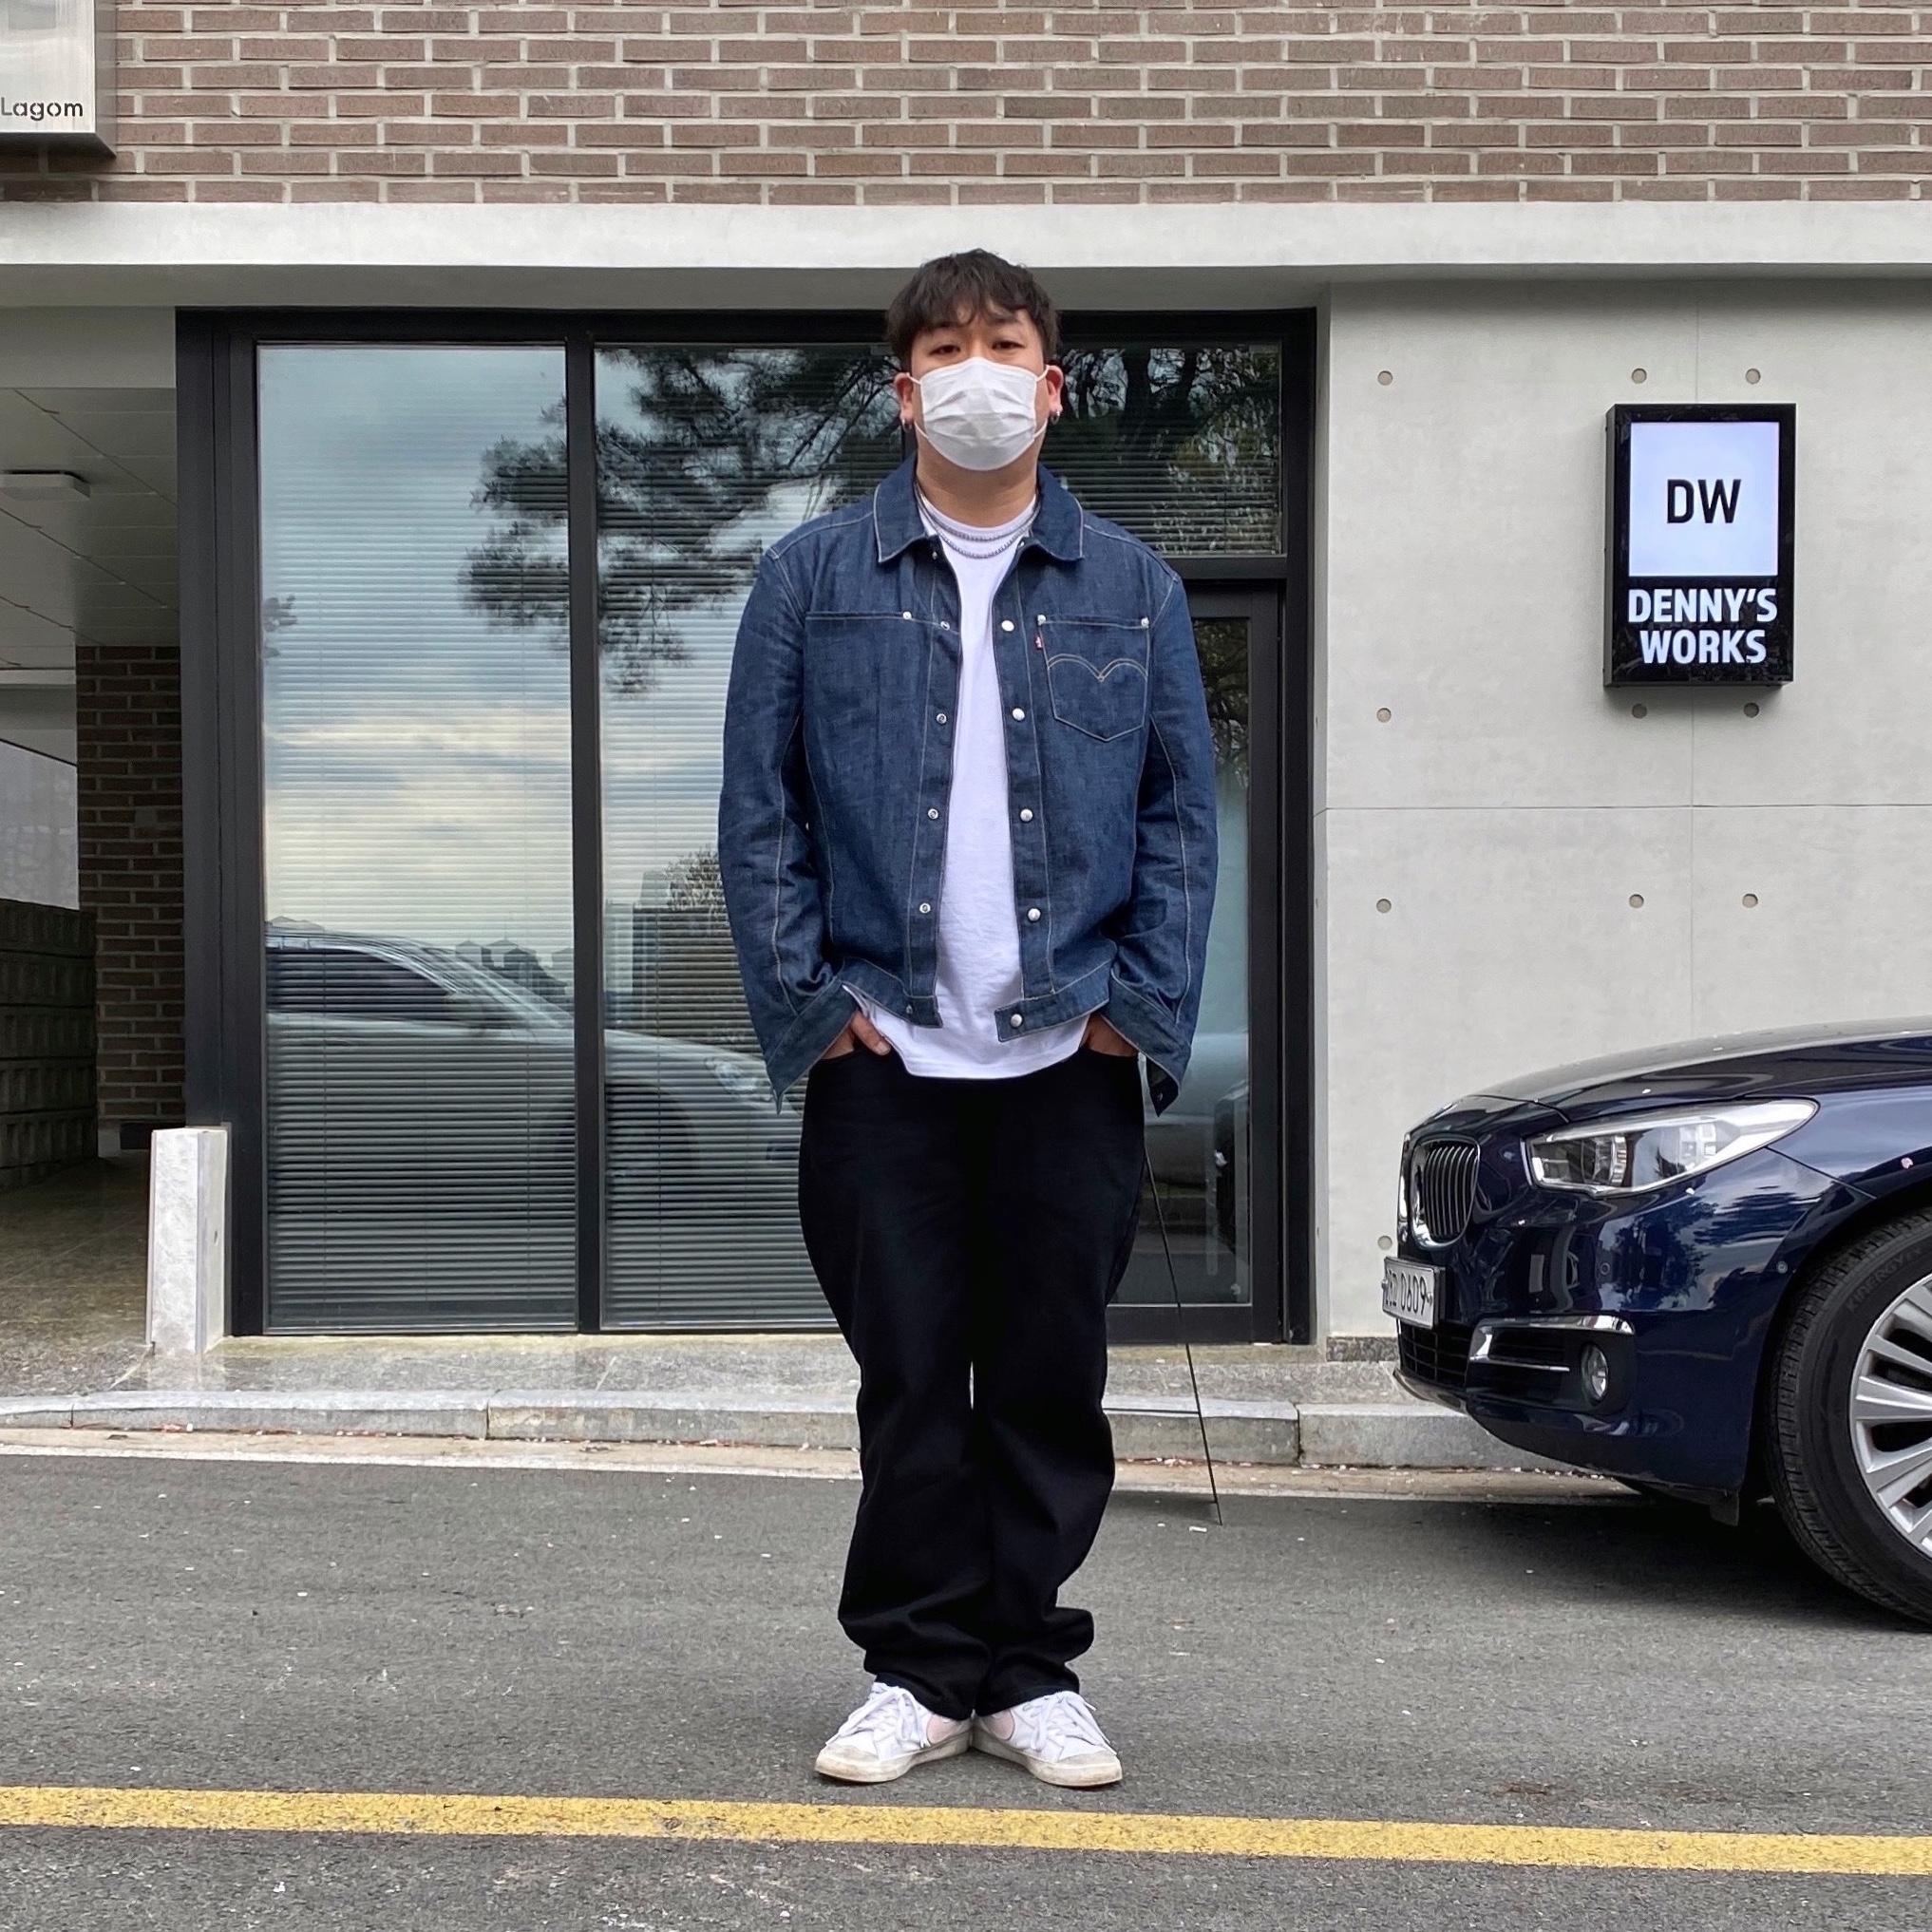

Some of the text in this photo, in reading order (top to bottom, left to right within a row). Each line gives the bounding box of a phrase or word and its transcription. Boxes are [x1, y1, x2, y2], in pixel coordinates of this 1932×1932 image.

[1, 97, 84, 122] Lagom
[1667, 479, 1742, 524] DW
[1628, 588, 1778, 623] DENNY'S
[1639, 630, 1767, 664] WORKS
